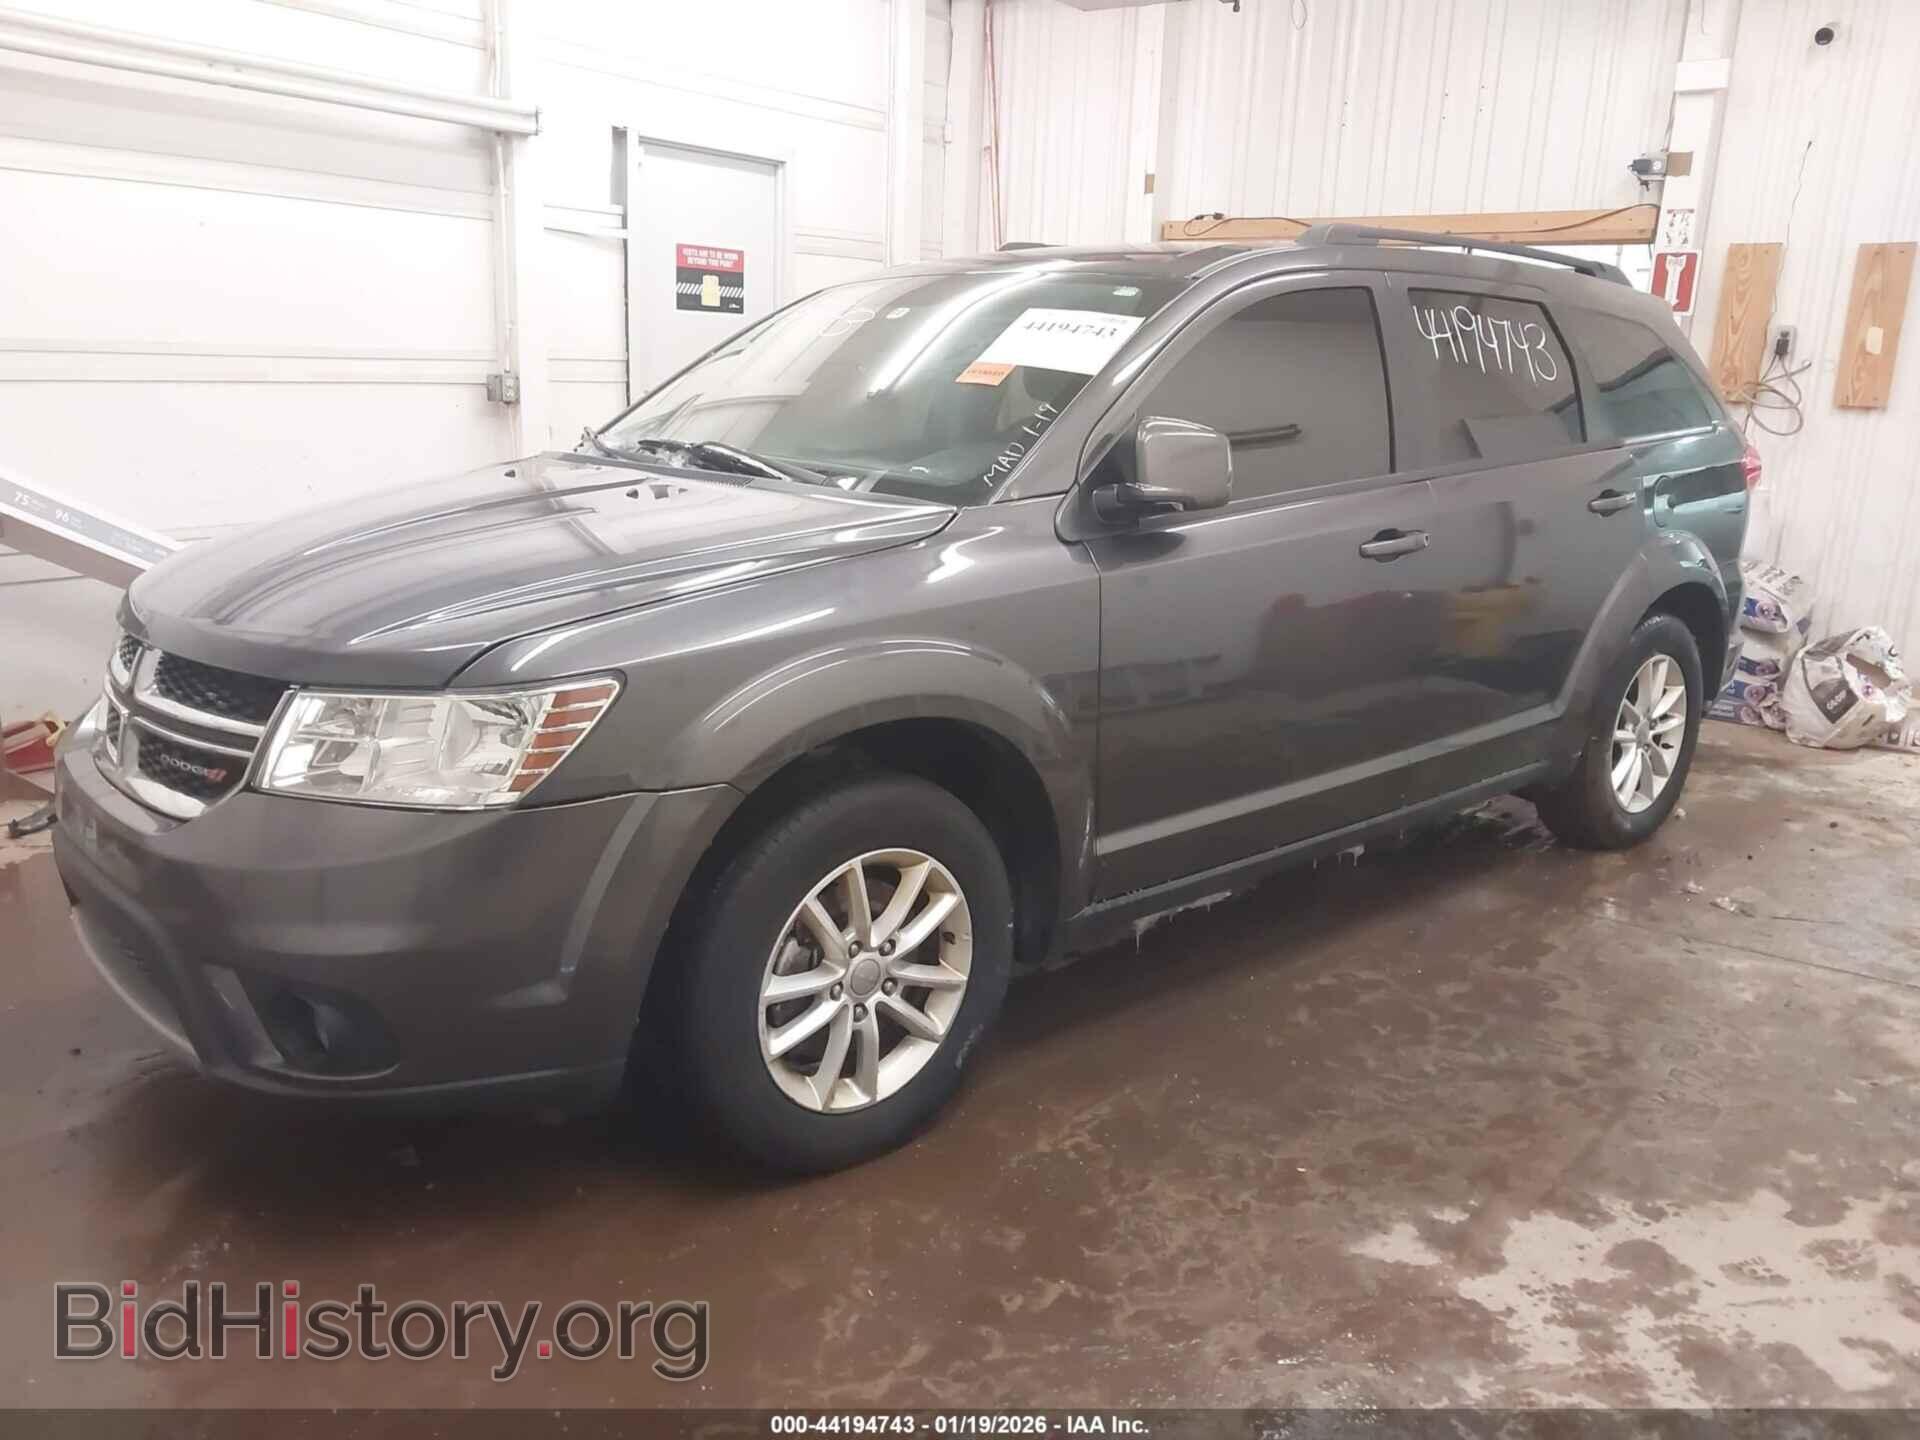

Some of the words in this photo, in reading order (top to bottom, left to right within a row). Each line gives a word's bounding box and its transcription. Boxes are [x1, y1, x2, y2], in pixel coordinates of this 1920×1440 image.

[1023, 320, 1118, 337] 44194743
[1412, 305, 1557, 383] 44194743
[14, 491, 30, 506] 75
